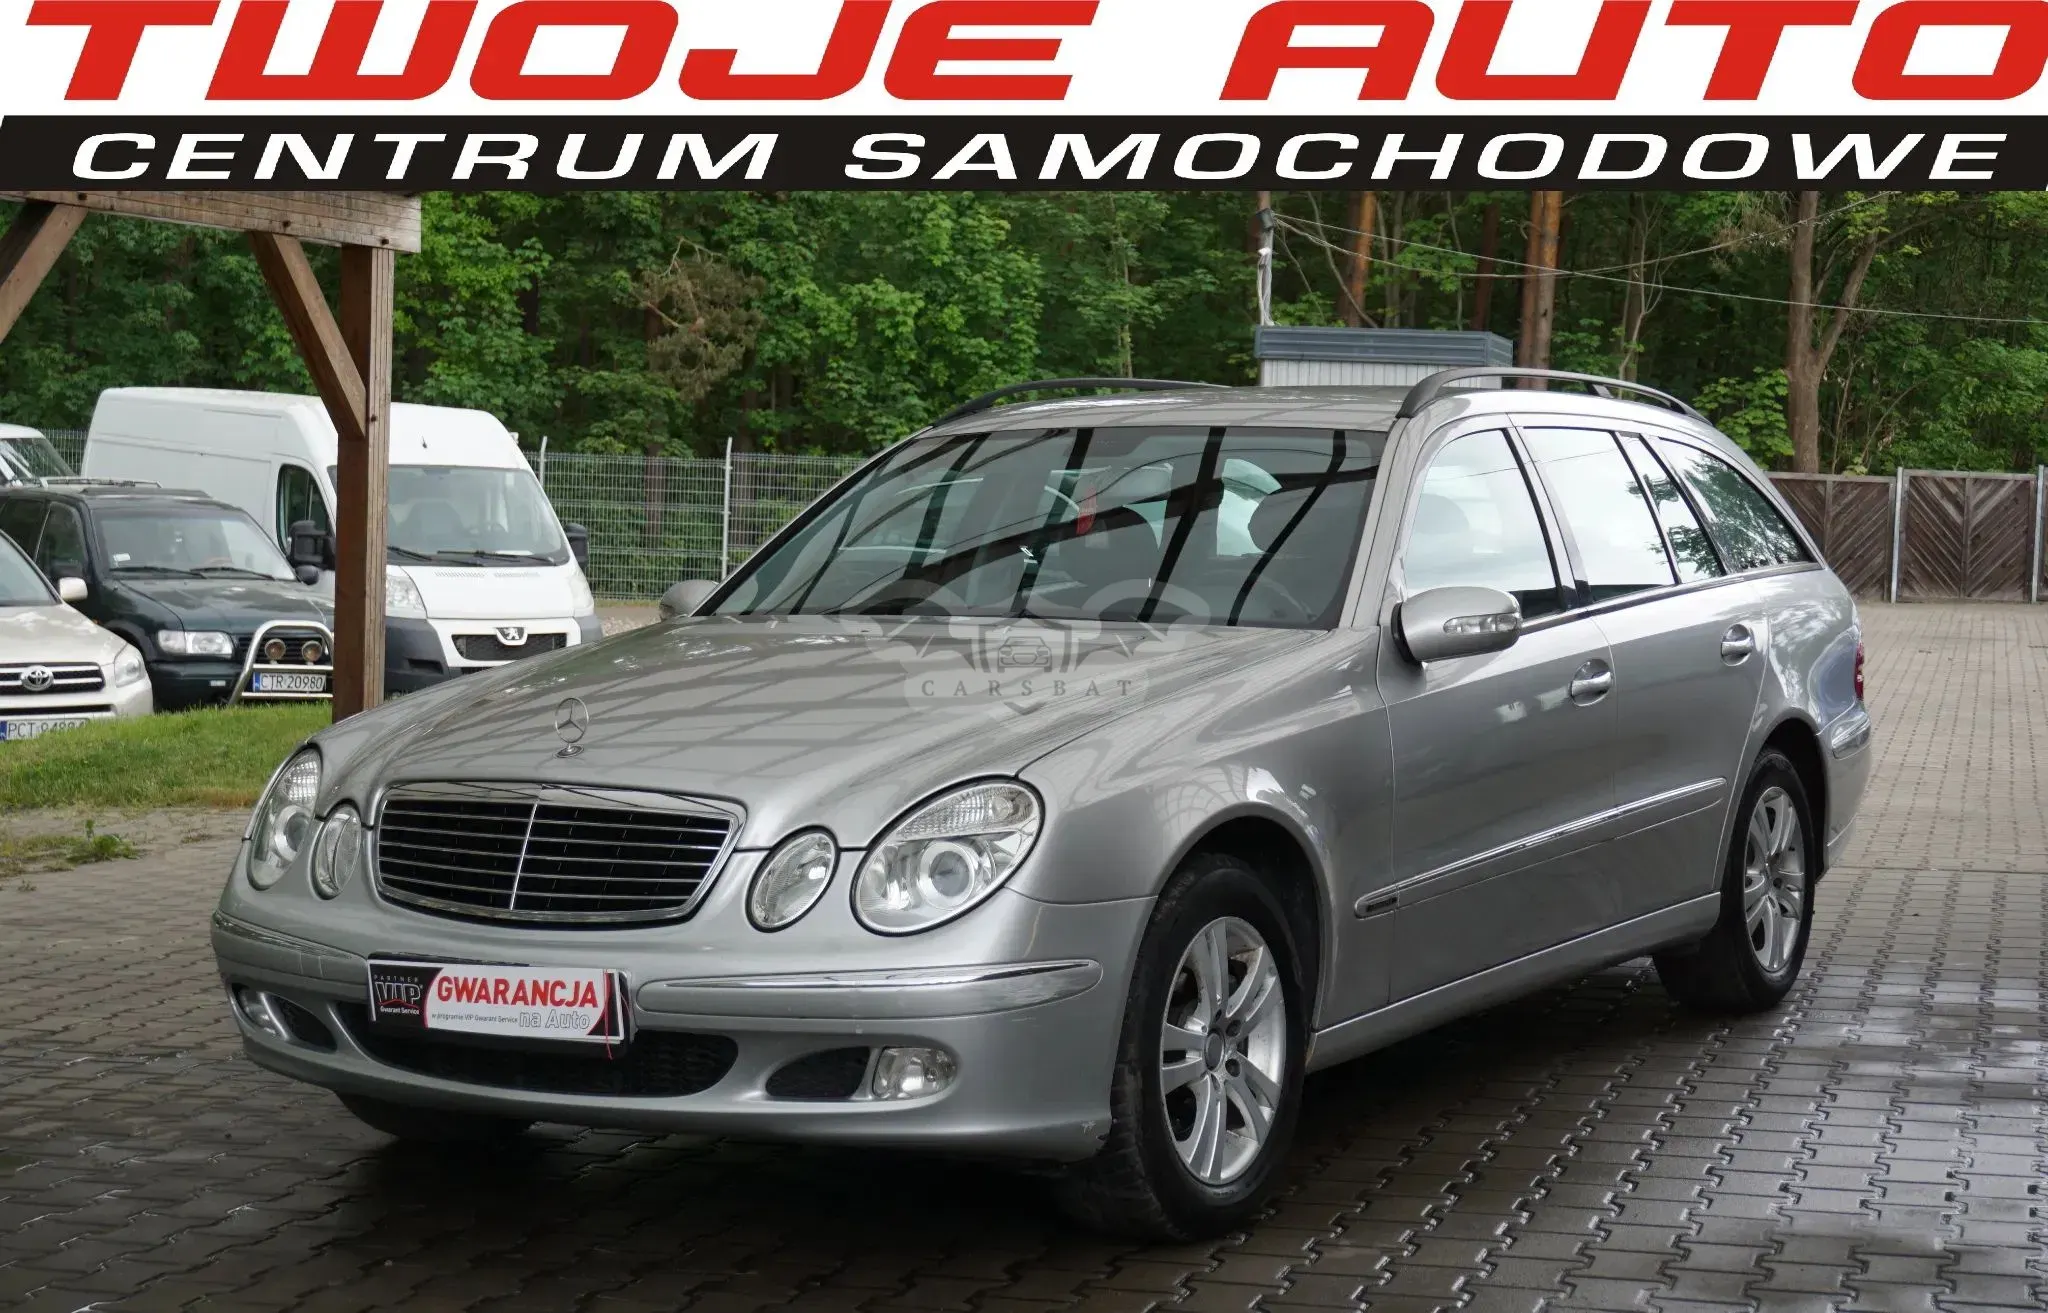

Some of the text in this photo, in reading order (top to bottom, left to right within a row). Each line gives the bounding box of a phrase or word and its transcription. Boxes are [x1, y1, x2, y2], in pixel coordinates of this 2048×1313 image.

[261, 674, 323, 691] CTR 20980
[8, 722, 36, 739] PCT
[374, 981, 421, 1005] VIP
[437, 975, 599, 1009] GWARANCJA
[401, 1006, 420, 1015] Service
[519, 1008, 591, 1031] na Auto
